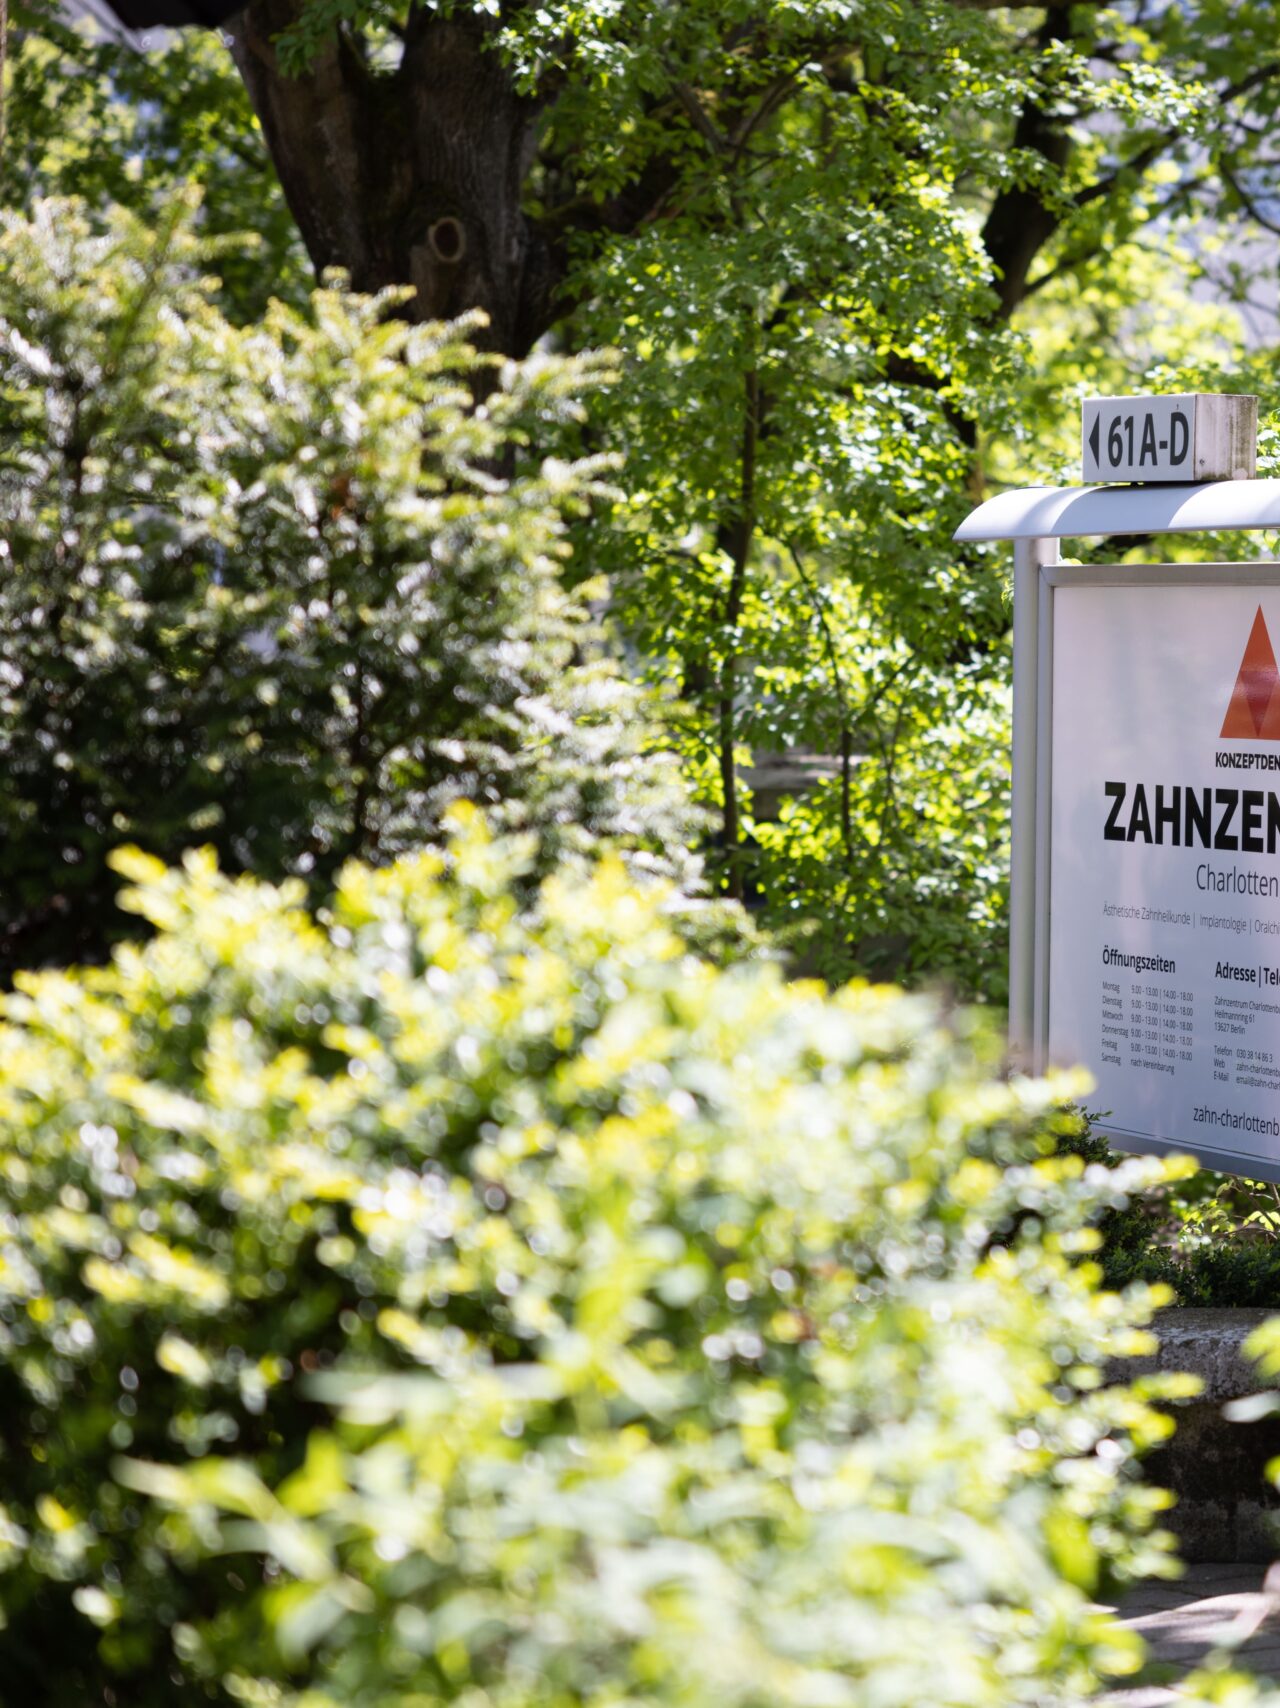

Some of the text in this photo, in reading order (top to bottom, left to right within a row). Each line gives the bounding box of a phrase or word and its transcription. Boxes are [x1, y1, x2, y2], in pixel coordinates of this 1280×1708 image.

[1103, 901, 1140, 919] Ästhetische
[1142, 908, 1191, 925] Zahnheilkunde
[1200, 914, 1247, 934] Implantologie
[1103, 945, 1175, 973] Öffnungszeiten
[1215, 962, 1256, 982] Adresse
[1231, 1024, 1245, 1034] Berlin
[1214, 1045, 1232, 1056] Telefon
